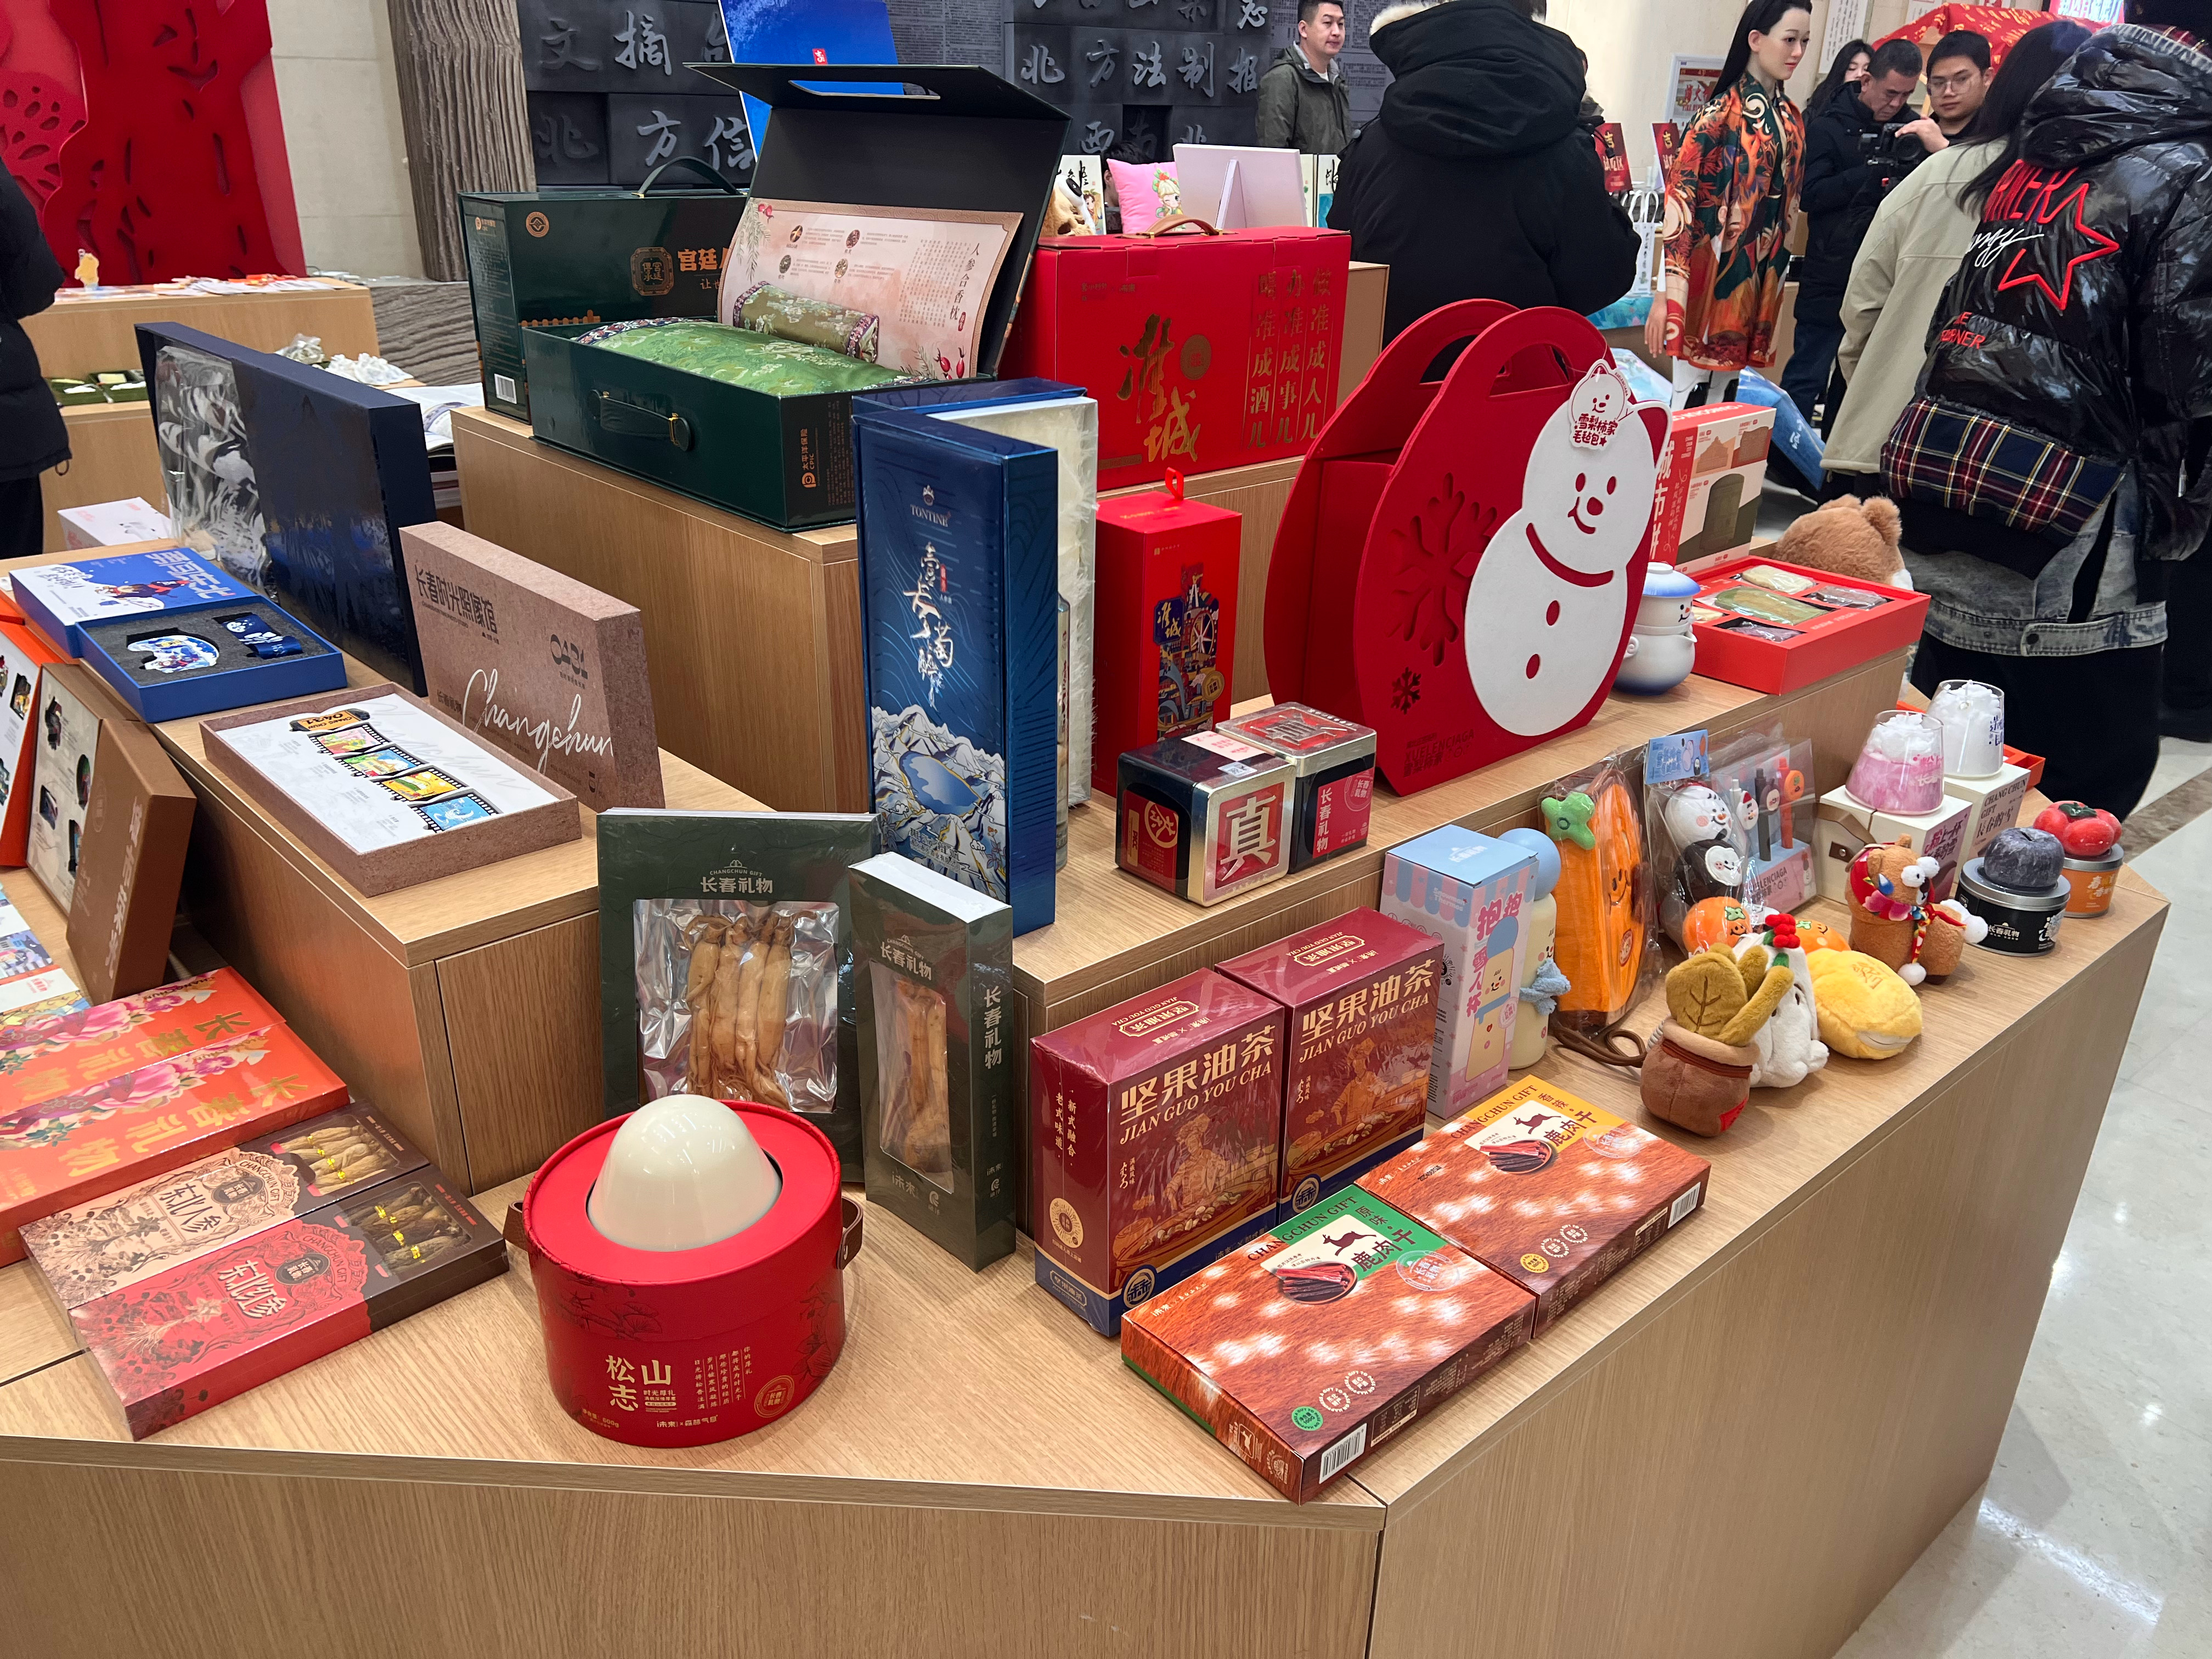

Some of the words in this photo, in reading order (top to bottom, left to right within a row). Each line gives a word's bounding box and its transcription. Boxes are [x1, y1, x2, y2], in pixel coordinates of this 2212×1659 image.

[1020, 40, 1259, 98] 北方法制报
[678, 248, 730, 272] 宫廷
[1573, 430, 1598, 445] 毛毡包
[1578, 413, 1618, 436] 雪梨柿家
[800, 428, 809, 471] 太平洋保险
[911, 504, 948, 527] TONTINE
[145, 550, 232, 599] 勇闯东北
[415, 565, 498, 635] 长春时光照像馆
[550, 634, 589, 680] 0431
[1404, 729, 1474, 763] XUELENCIAGA
[1980, 804, 1997, 820] GIFT
[1984, 788, 2008, 807] CHANG
[2007, 777, 2028, 795] CHUN
[1220, 794, 1277, 882] 真
[1316, 787, 1333, 853] 长春礼物
[699, 877, 774, 895] 长春礼物
[709, 868, 748, 877] CHANGCHUN
[1433, 887, 1465, 905] Snowman
[1434, 894, 1464, 912] Thermos
[1476, 890, 1523, 941] 抱抱
[887, 938, 915, 956] CHANGCHUN
[915, 952, 924, 960] GIFT
[1303, 938, 1356, 962] 坚果油茶
[1988, 924, 2020, 938] 长春礼物
[881, 942, 932, 981] 长春礼物
[1467, 946, 1489, 1018] 雪人杯
[1129, 1005, 1190, 1032] 坚果油茶
[1300, 958, 1436, 1046] 坚果油茶
[984, 985, 1002, 1070] 长春礼物
[1299, 1035, 1335, 1063] JIAN
[1336, 1021, 1367, 1045] GUO
[1370, 1005, 1400, 1029] YOU
[1401, 992, 1430, 1014] CHA
[13, 1011, 251, 1102] 长春礼物
[1120, 1024, 1276, 1125] 坚果油茶
[1054, 1092, 1064, 1151] 老式味道
[1120, 1110, 1162, 1145] JIAN
[1164, 1094, 1199, 1123] GUO
[1204, 1077, 1237, 1103] YOU
[1239, 1060, 1272, 1086] CHA
[1450, 1099, 1516, 1140] CHANGCHUN
[1513, 1085, 1539, 1102] GIFT
[1538, 1092, 1570, 1110] 香辣
[58, 1074, 308, 1177] 长春礼物
[1067, 1098, 1076, 1158] 新式融合
[1543, 1110, 1598, 1147] 鹿肉干
[239, 1160, 278, 1188] CHANGCHUN
[270, 1188, 280, 1202] GIFT
[159, 1183, 223, 1233] 东北人参
[1248, 1211, 1330, 1262] CHANGCHUN
[1327, 1196, 1358, 1216] GIFT
[1355, 1204, 1389, 1226] 原味
[302, 1234, 345, 1268] CHANGCHUN
[336, 1268, 347, 1284] GIFT
[1351, 1227, 1417, 1273] 鹿肉干
[217, 1259, 287, 1319] 东北红参
[719, 1353, 730, 1405] 那些珍贵的经历
[743, 1346, 753, 1375] 你的厚礼
[608, 1384, 639, 1412] 志
